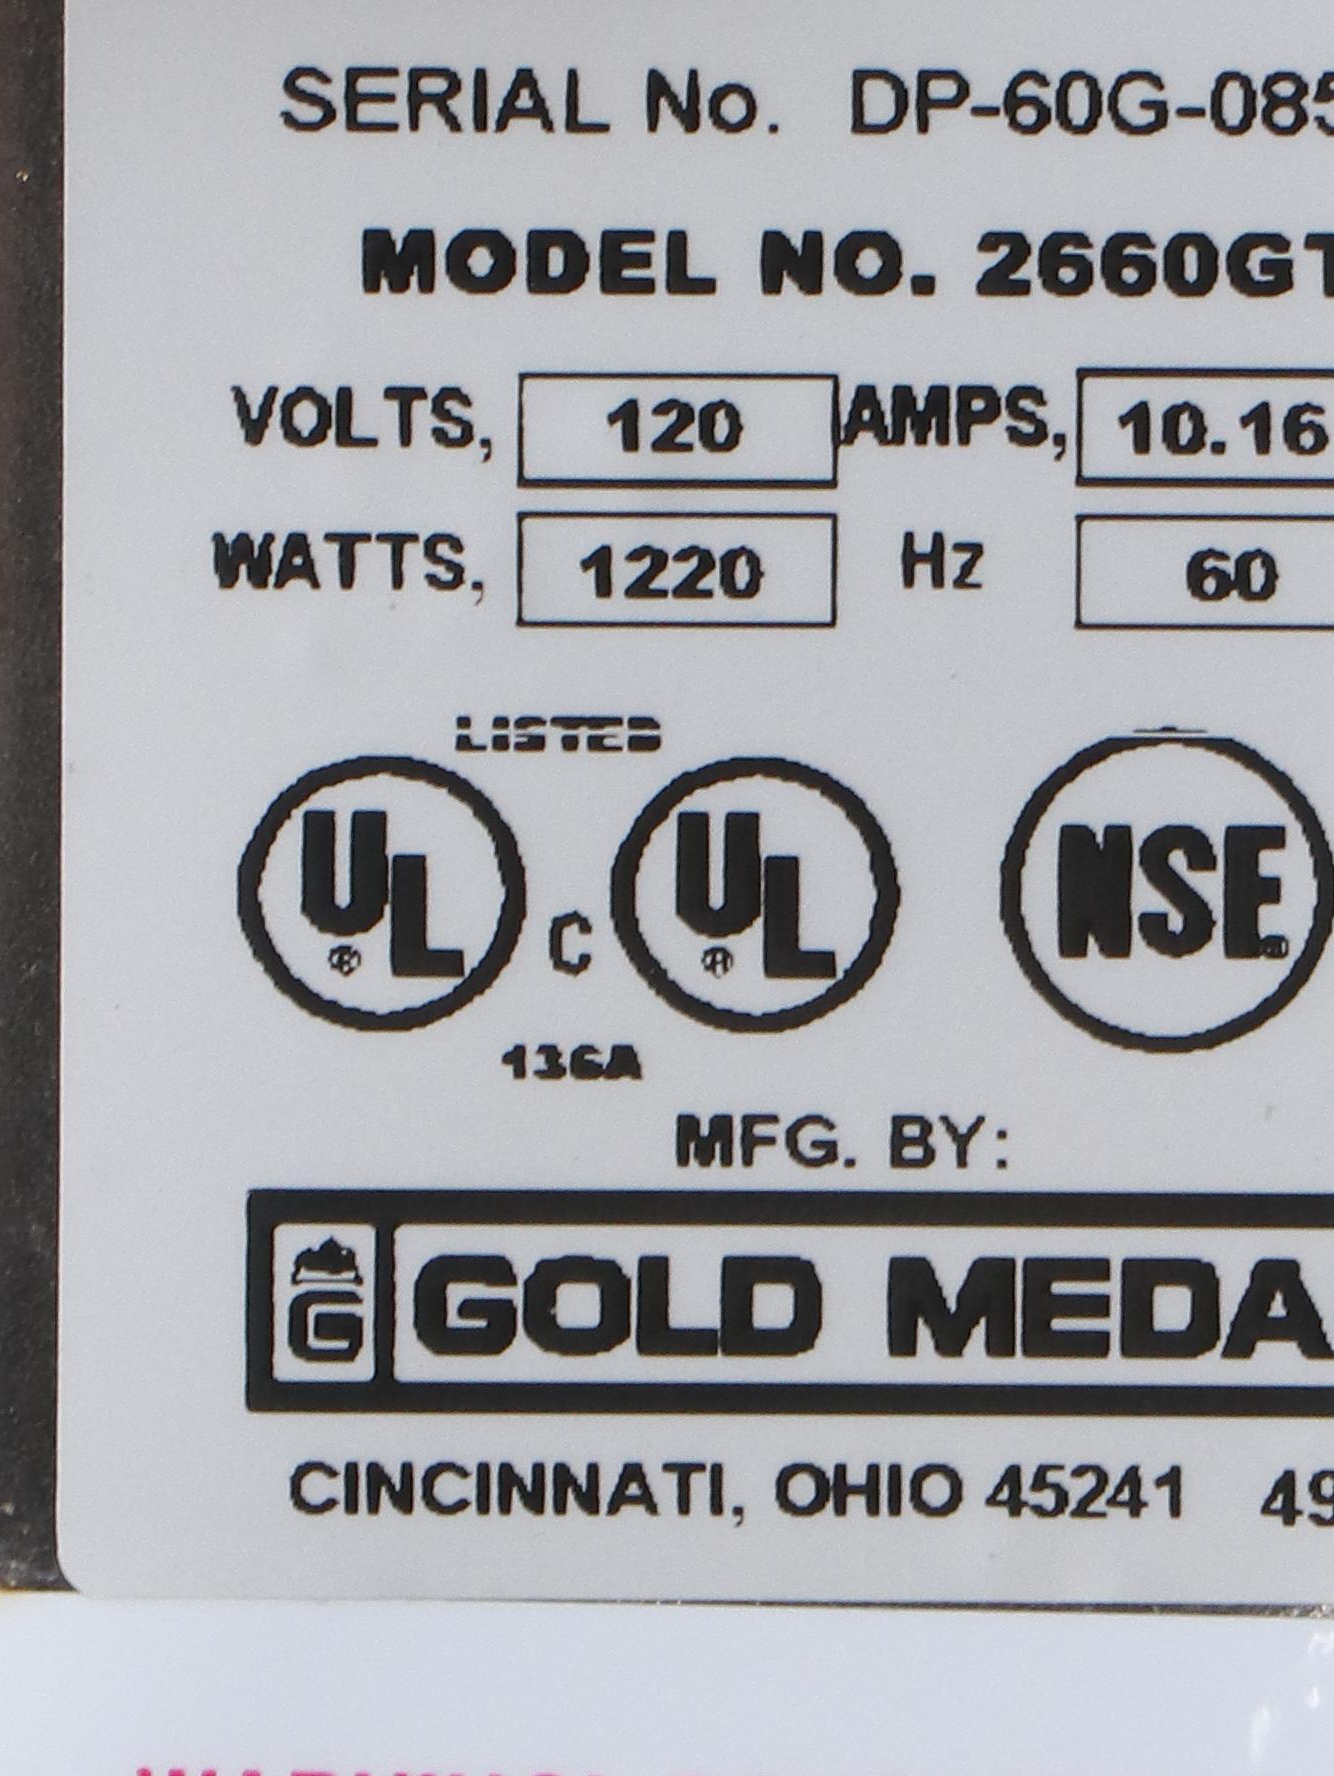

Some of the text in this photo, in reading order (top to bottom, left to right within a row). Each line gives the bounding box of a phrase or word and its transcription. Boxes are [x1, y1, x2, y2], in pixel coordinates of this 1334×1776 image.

[279, 65, 612, 135] SERIAL
[645, 67, 780, 135] No.
[360, 227, 718, 297] MODEL
[759, 229, 937, 297] NO.
[230, 383, 1331, 464] VOLTS, 120 AMPS, 10.16
[210, 530, 1281, 605] WATTS, 1220 Hz 60
[674, 1113, 1009, 1170] MFG. BY:
[411, 1253, 824, 1359] GOLD
[288, 1460, 745, 1528] CINCINNATI,
[774, 1461, 965, 1519] OHIO
[984, 1463, 1183, 1520] 45241
